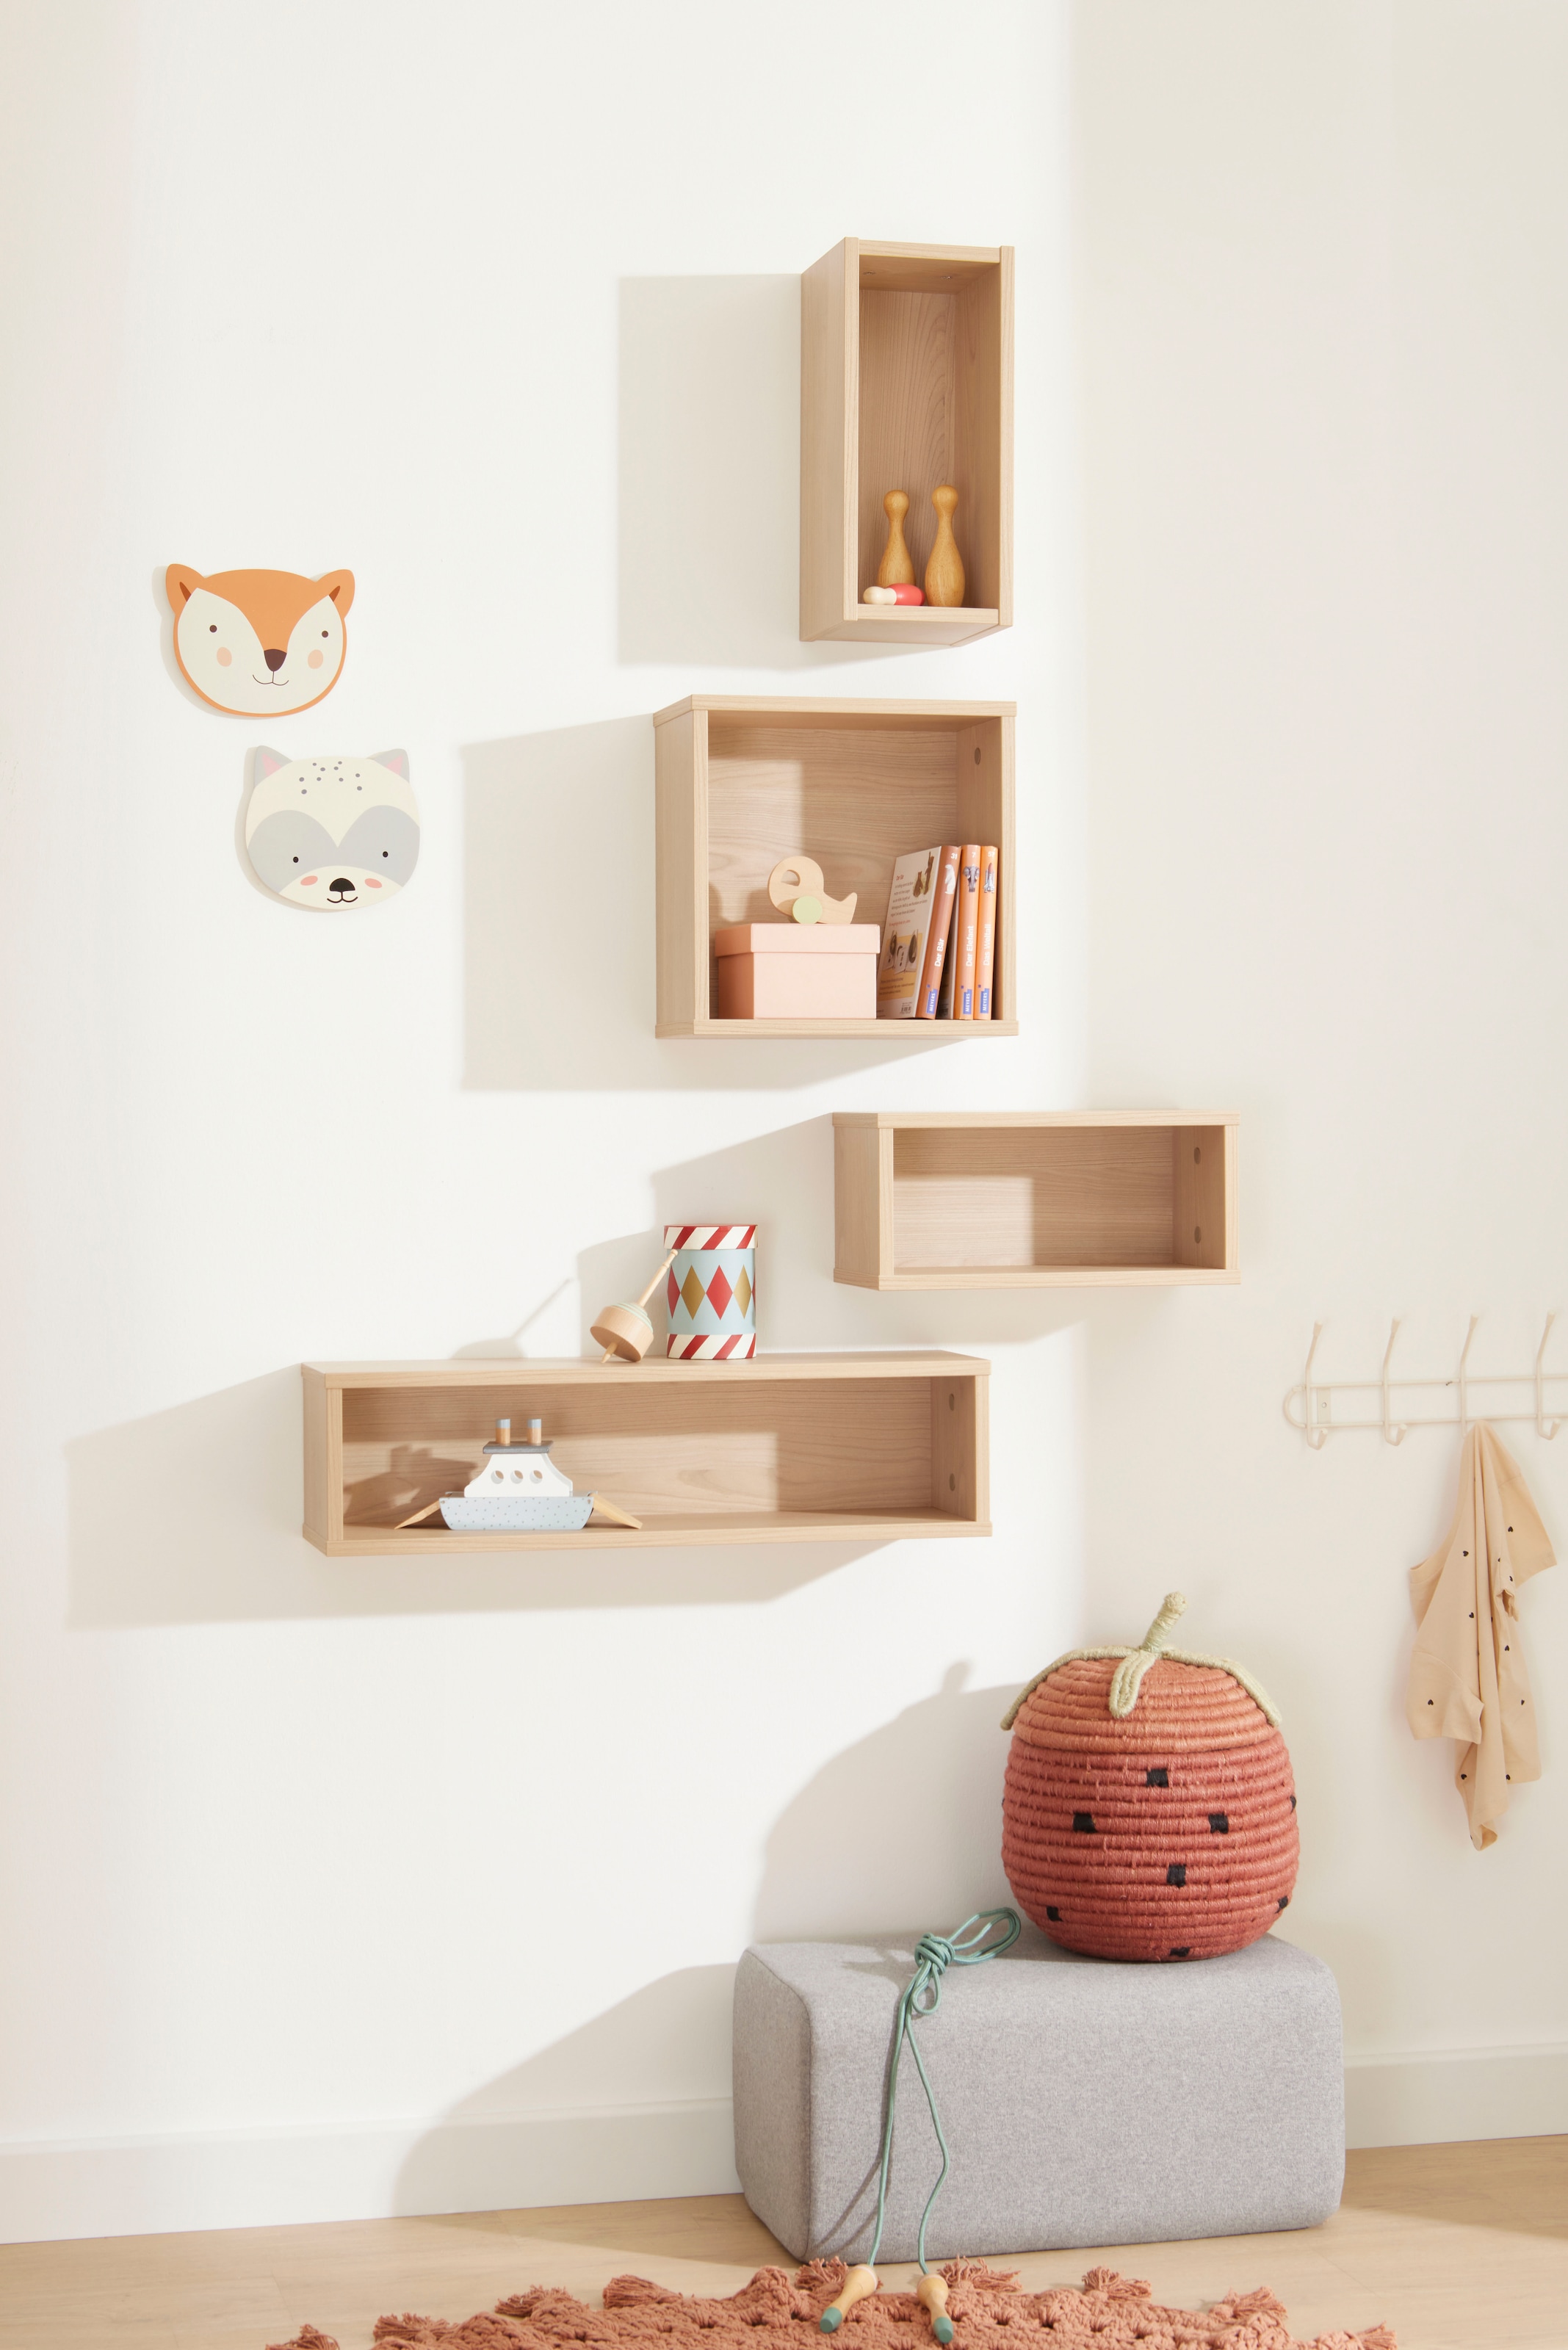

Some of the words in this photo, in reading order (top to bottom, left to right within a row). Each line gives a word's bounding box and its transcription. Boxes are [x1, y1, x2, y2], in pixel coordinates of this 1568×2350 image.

[983, 923, 991, 950] Weltall
[936, 938, 944, 952] Bär
[934, 953, 942, 966] Der
